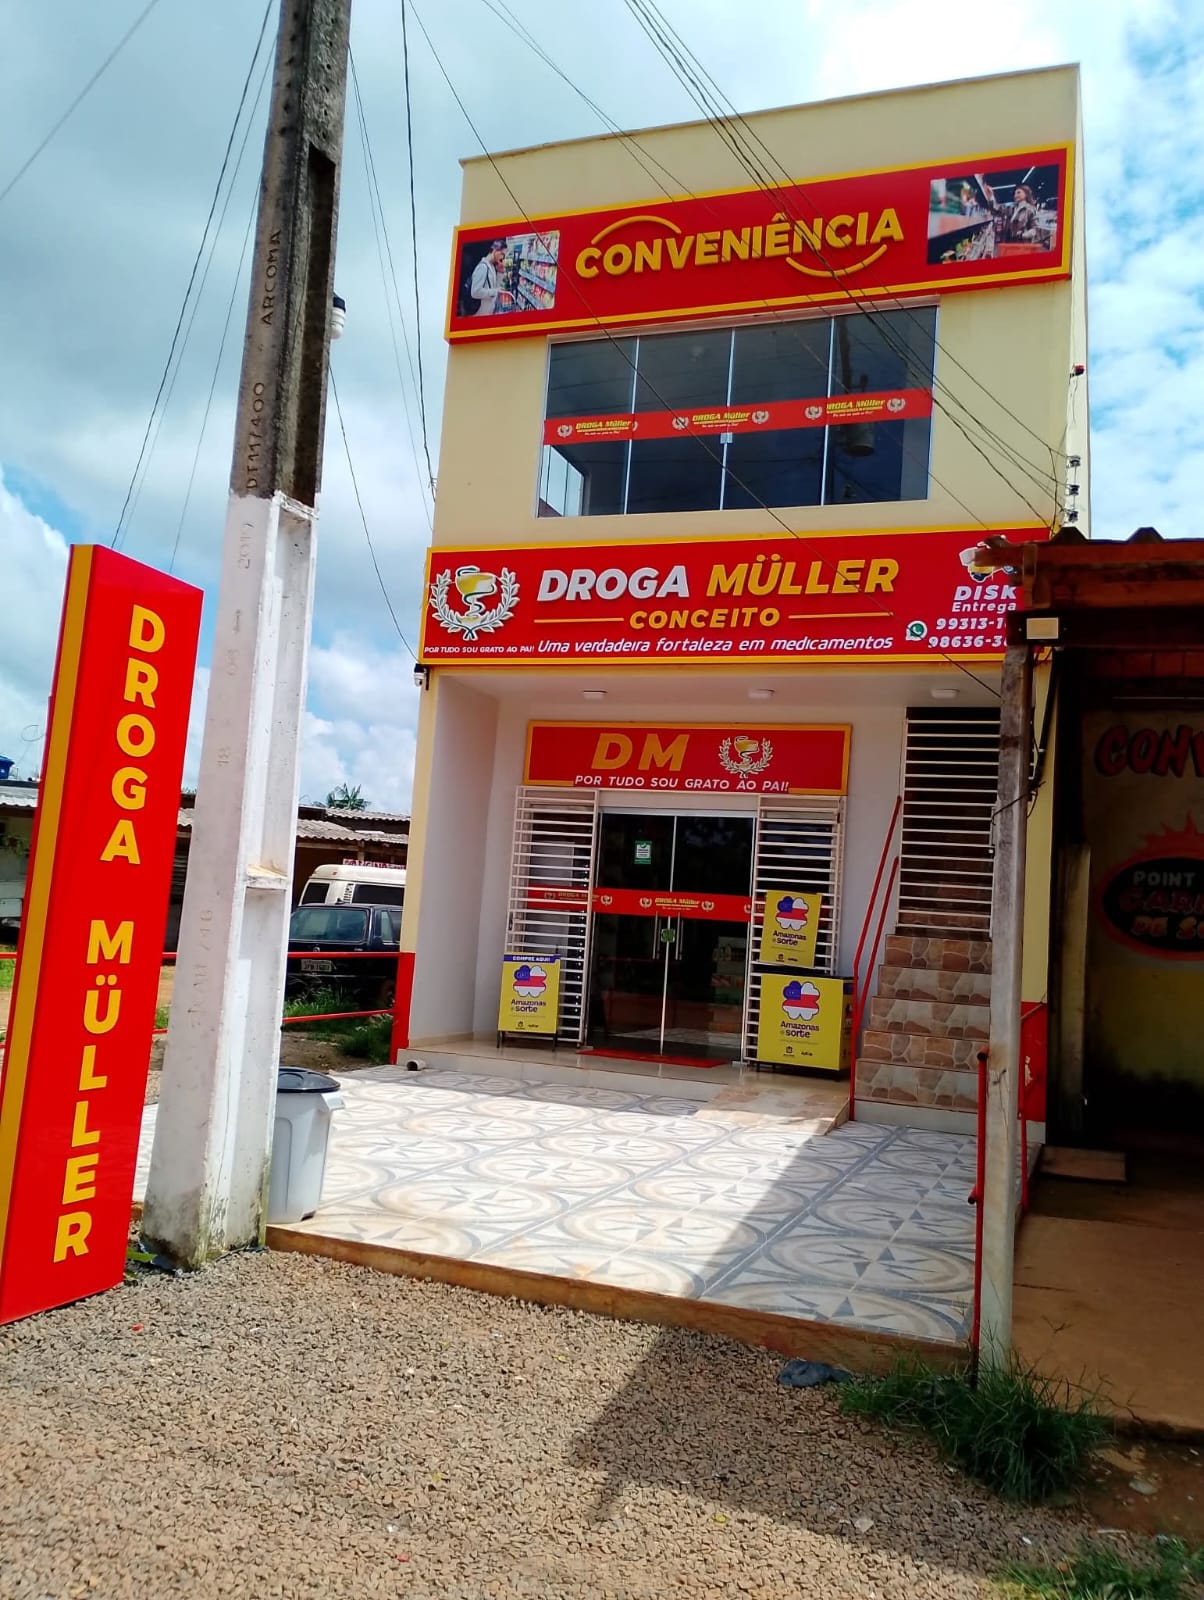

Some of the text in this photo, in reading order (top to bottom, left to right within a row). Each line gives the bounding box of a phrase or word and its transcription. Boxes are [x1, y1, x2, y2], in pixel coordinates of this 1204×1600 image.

[576, 208, 904, 279] CONVENIÊNCIA
[261, 229, 281, 326] ARCOMA
[537, 553, 899, 602] DROGA MÜLLER
[954, 584, 1017, 601] DISK
[952, 602, 1017, 614] Entrega
[629, 607, 781, 629] CONCEITO
[936, 617, 1007, 630] 99313-1
[507, 645, 517, 653] AO
[538, 636, 893, 653] Uma verdadeira fortaleza em medicamentos
[100, 604, 166, 866] DROGA
[591, 733, 690, 772] DM
[575, 774, 789, 792] POR TUDO SOU GRATO AO PAI!
[1132, 870, 1196, 888] POINT
[773, 930, 807, 941] Amazonas
[511, 998, 547, 1007] Amazonas
[780, 1020, 820, 1031] Amazonas
[53, 919, 134, 1263] MÜLLER
